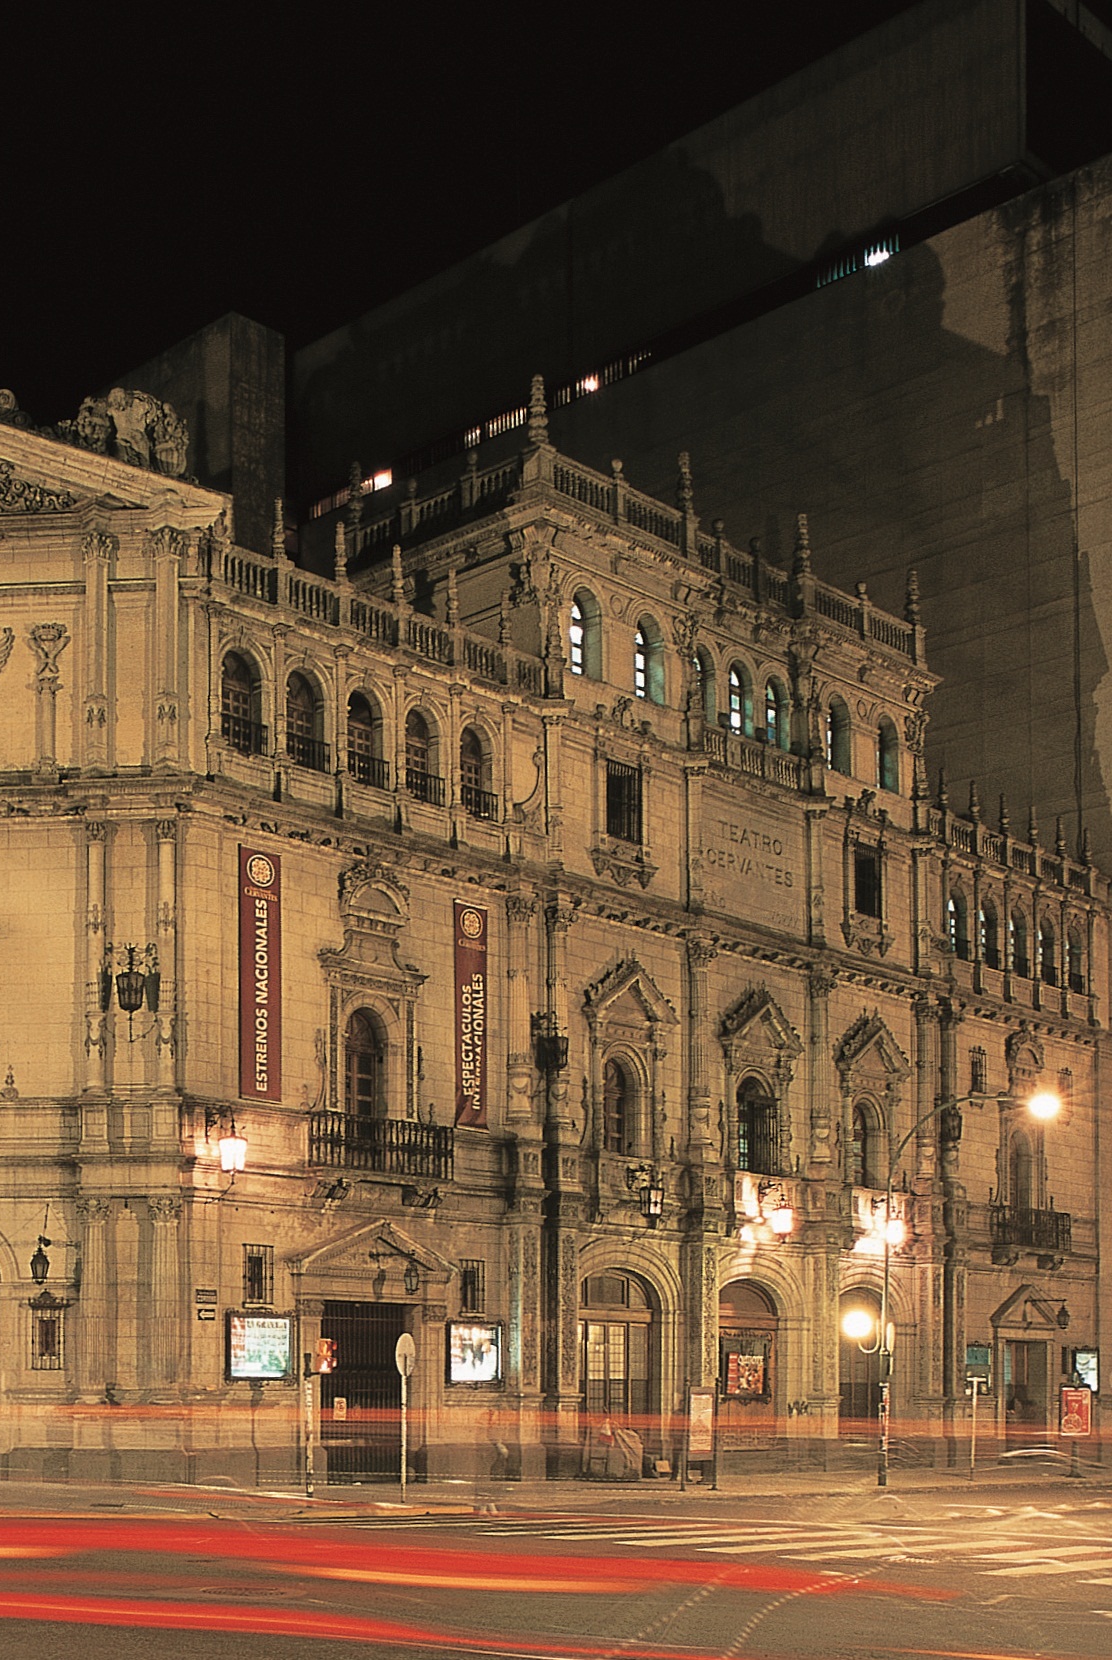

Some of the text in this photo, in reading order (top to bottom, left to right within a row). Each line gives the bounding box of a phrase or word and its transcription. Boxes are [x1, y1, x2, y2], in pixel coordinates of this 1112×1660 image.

[706, 848, 793, 888] CERVANTES
[717, 820, 783, 856] TEATRO
[254, 899, 269, 1005] NACIONALES
[255, 1007, 268, 1092] ESTRENOS
[461, 984, 475, 1096] ESPECTACULOS
